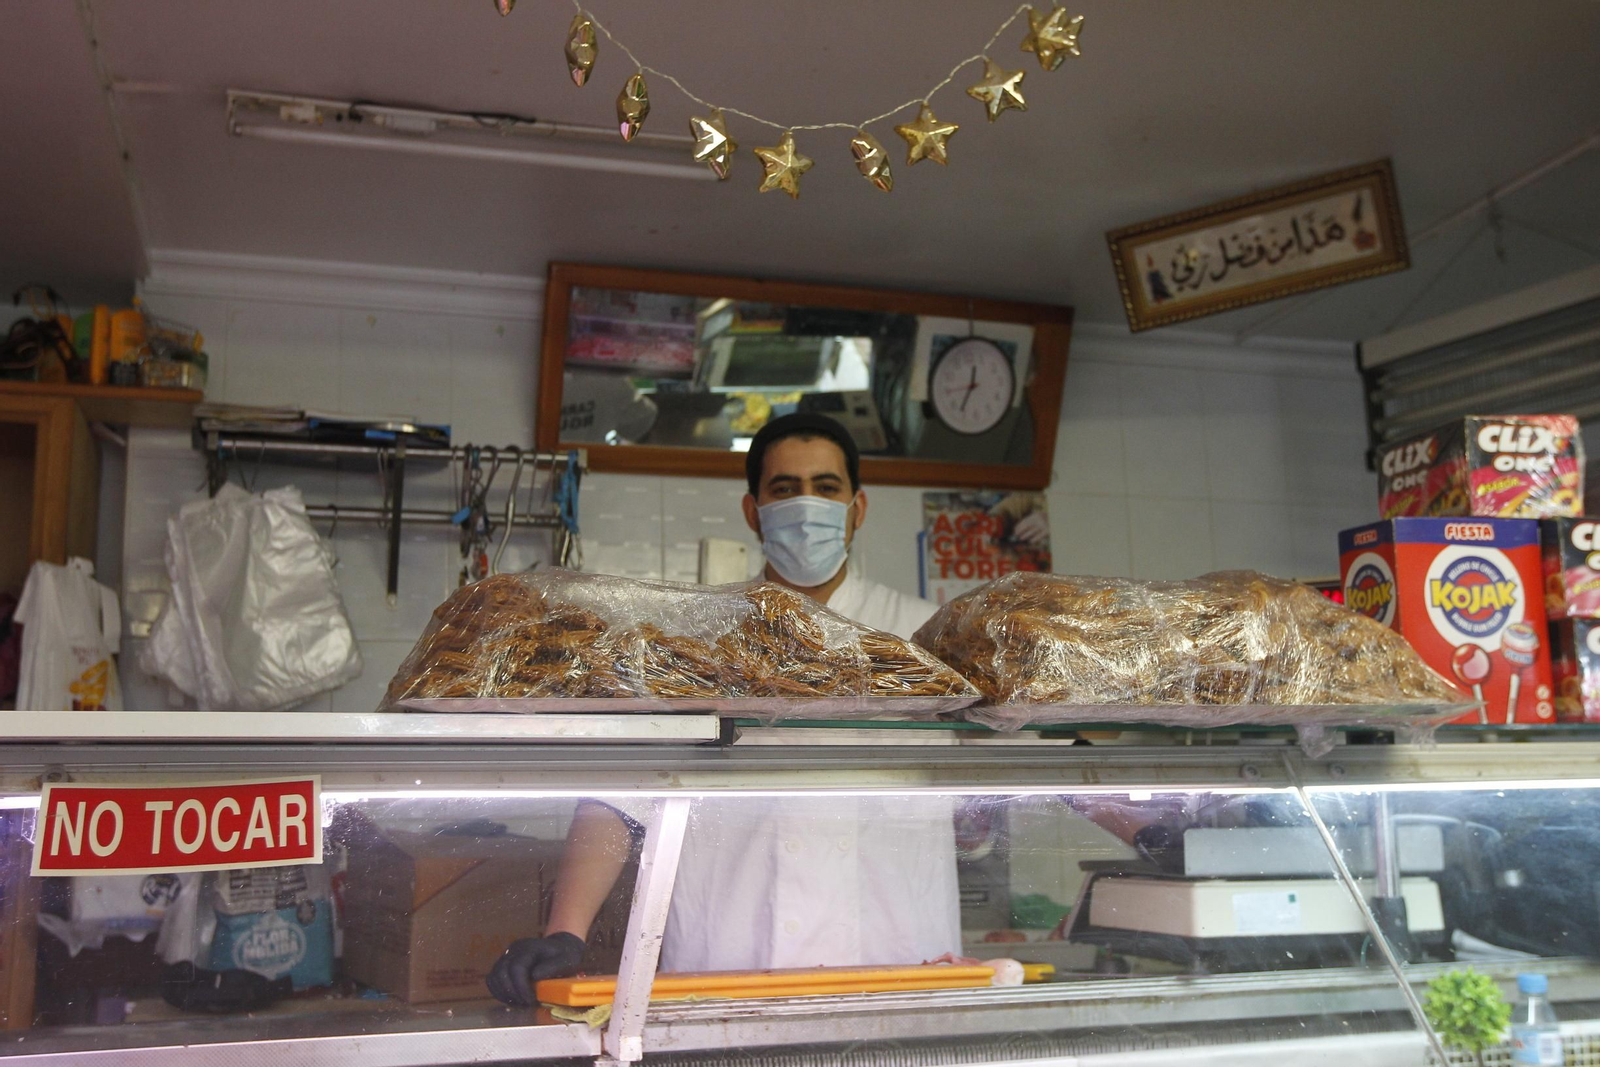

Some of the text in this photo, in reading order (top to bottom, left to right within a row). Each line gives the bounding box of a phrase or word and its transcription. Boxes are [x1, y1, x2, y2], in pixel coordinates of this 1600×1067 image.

[1444, 523, 1495, 540] FIESTA
[934, 535, 994, 557] CUL
[935, 557, 1013, 580] TORE
[1346, 581, 1392, 611] KOJAK
[1430, 579, 1517, 614] KOJAK
[50, 794, 307, 857] NO TOCAR
